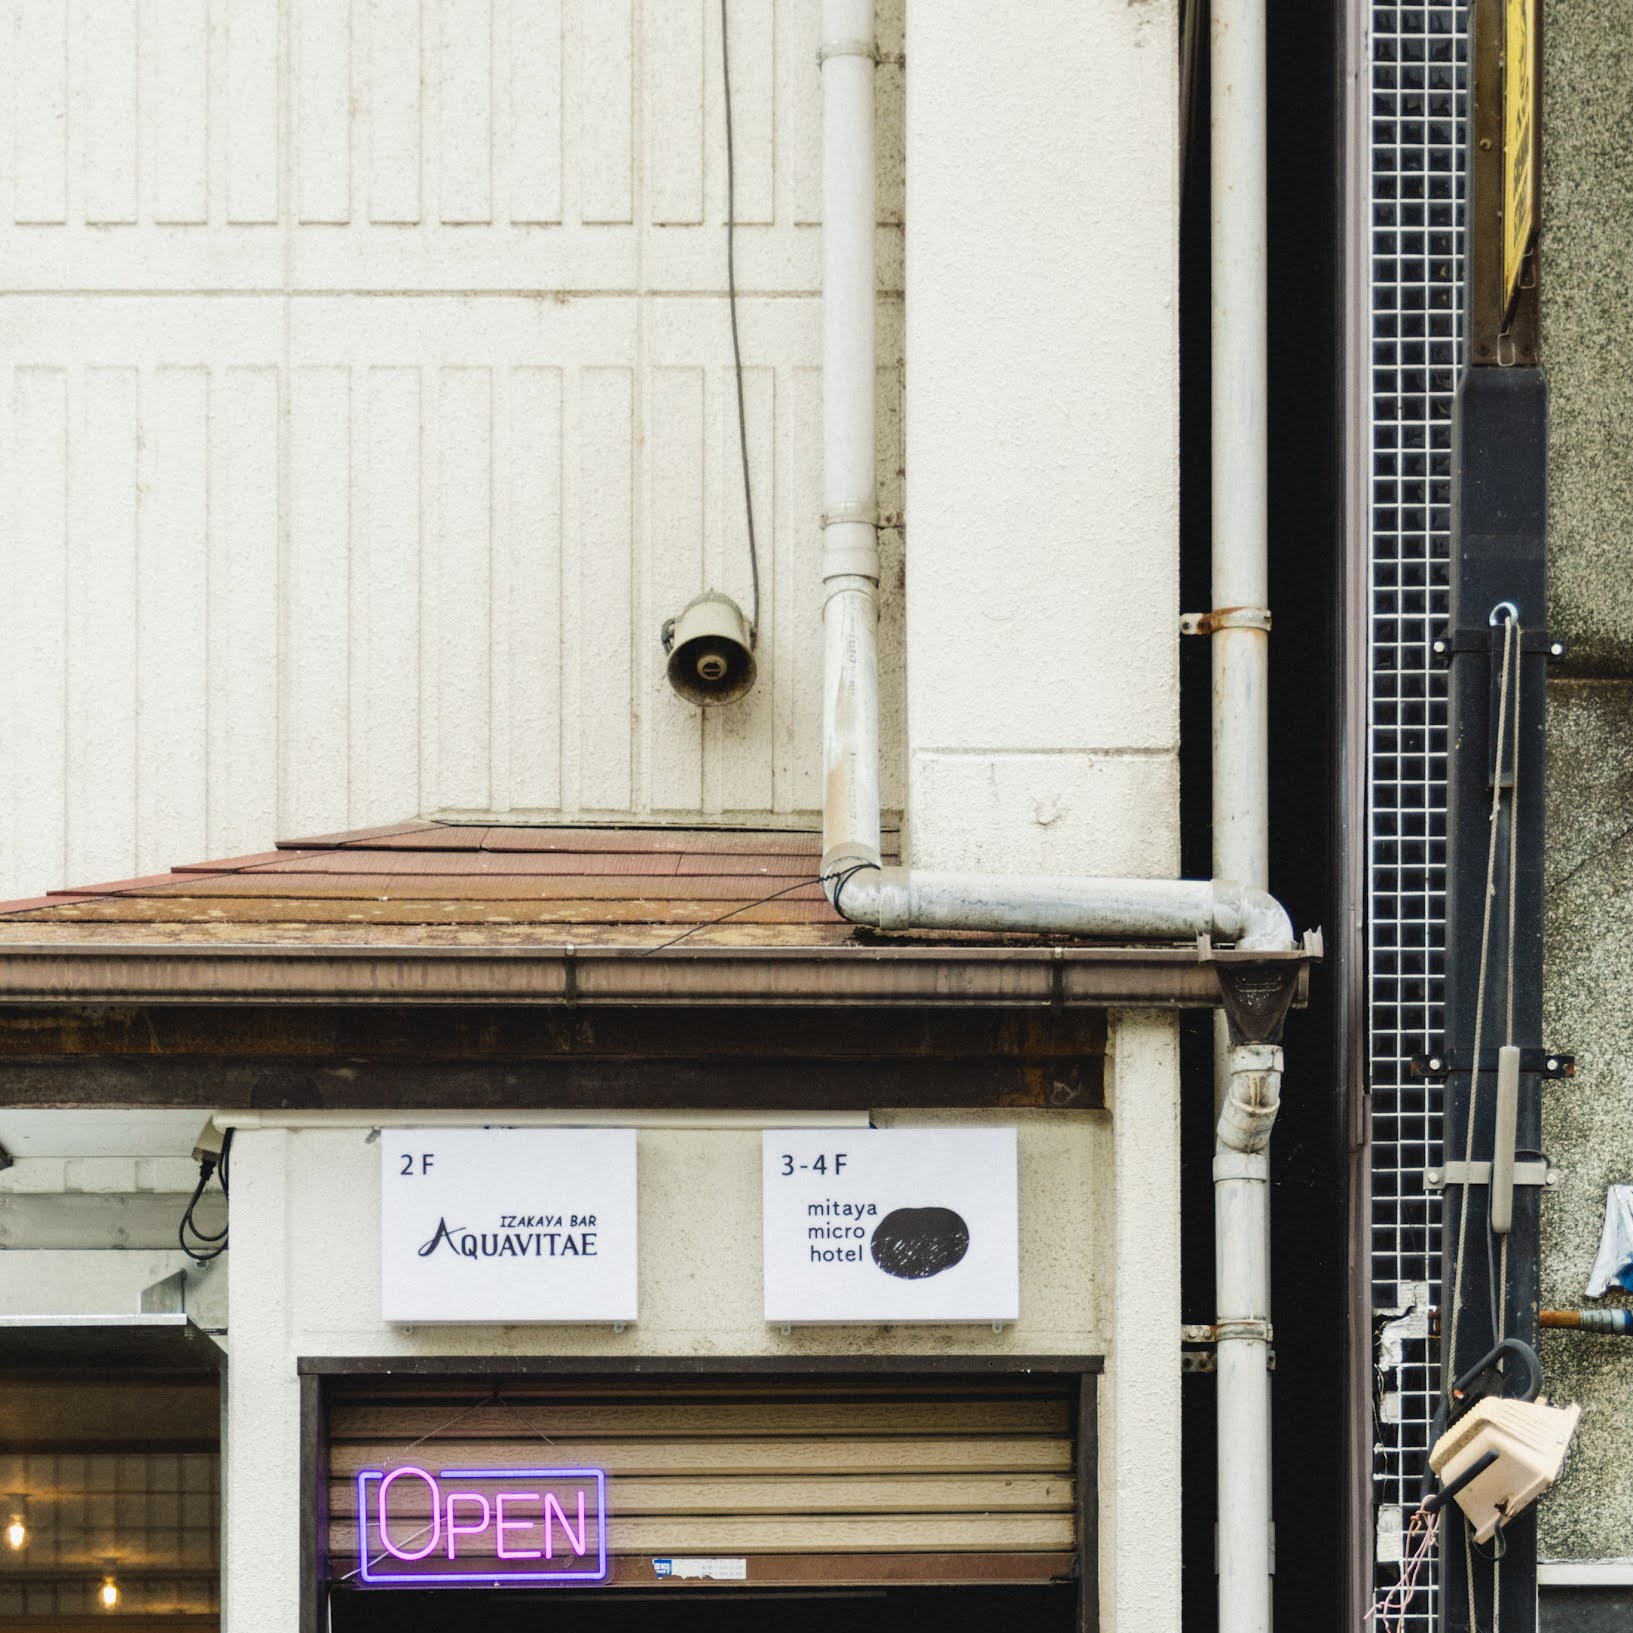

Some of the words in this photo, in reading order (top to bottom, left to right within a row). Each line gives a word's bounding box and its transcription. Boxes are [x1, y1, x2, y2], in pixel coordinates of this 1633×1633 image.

[808, 1198, 878, 1221] mitaya
[500, 1215, 563, 1228] IZAKAYA
[570, 1215, 597, 1228] BAR
[808, 1221, 866, 1239] micro
[418, 1216, 598, 1260] AQUAVITAE
[810, 1244, 863, 1262] hotel
[378, 1465, 587, 1562] OPEN
